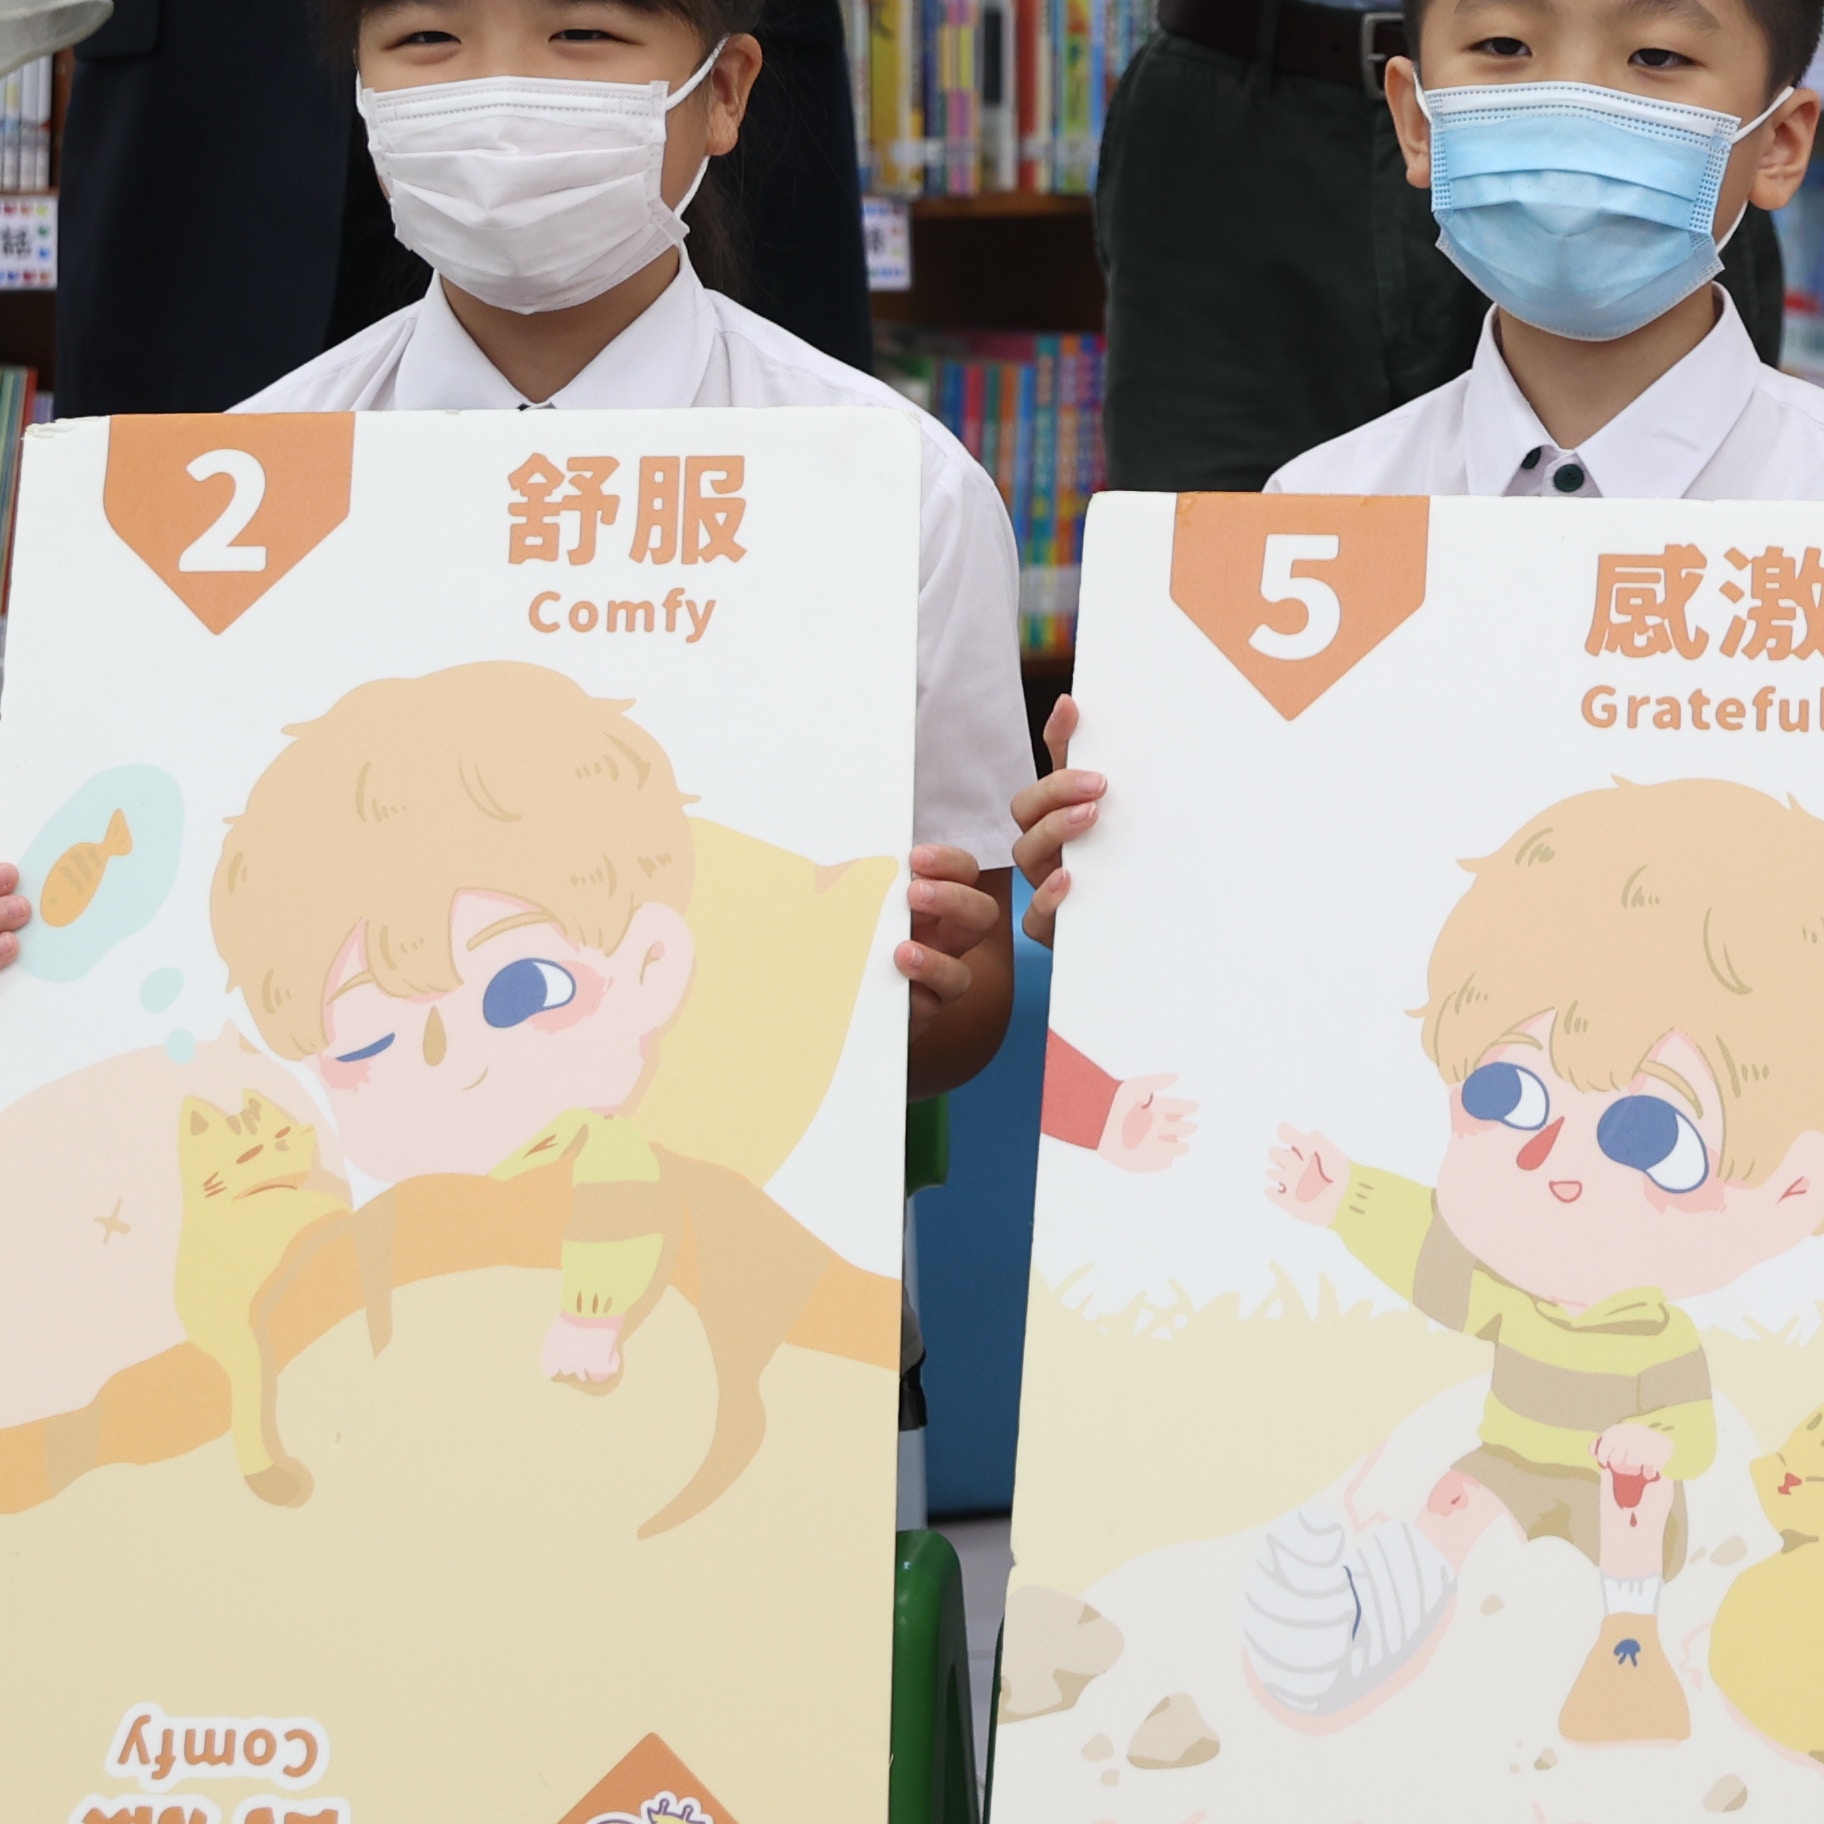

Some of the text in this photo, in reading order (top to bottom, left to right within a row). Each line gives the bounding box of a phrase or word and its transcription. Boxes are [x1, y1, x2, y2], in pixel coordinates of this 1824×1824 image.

[178, 448, 267, 573] 2
[507, 452, 747, 566] 舒服
[528, 588, 716, 644] Comfy
[1247, 533, 1342, 662] 5
[117, 1714, 318, 1780] Comfy
